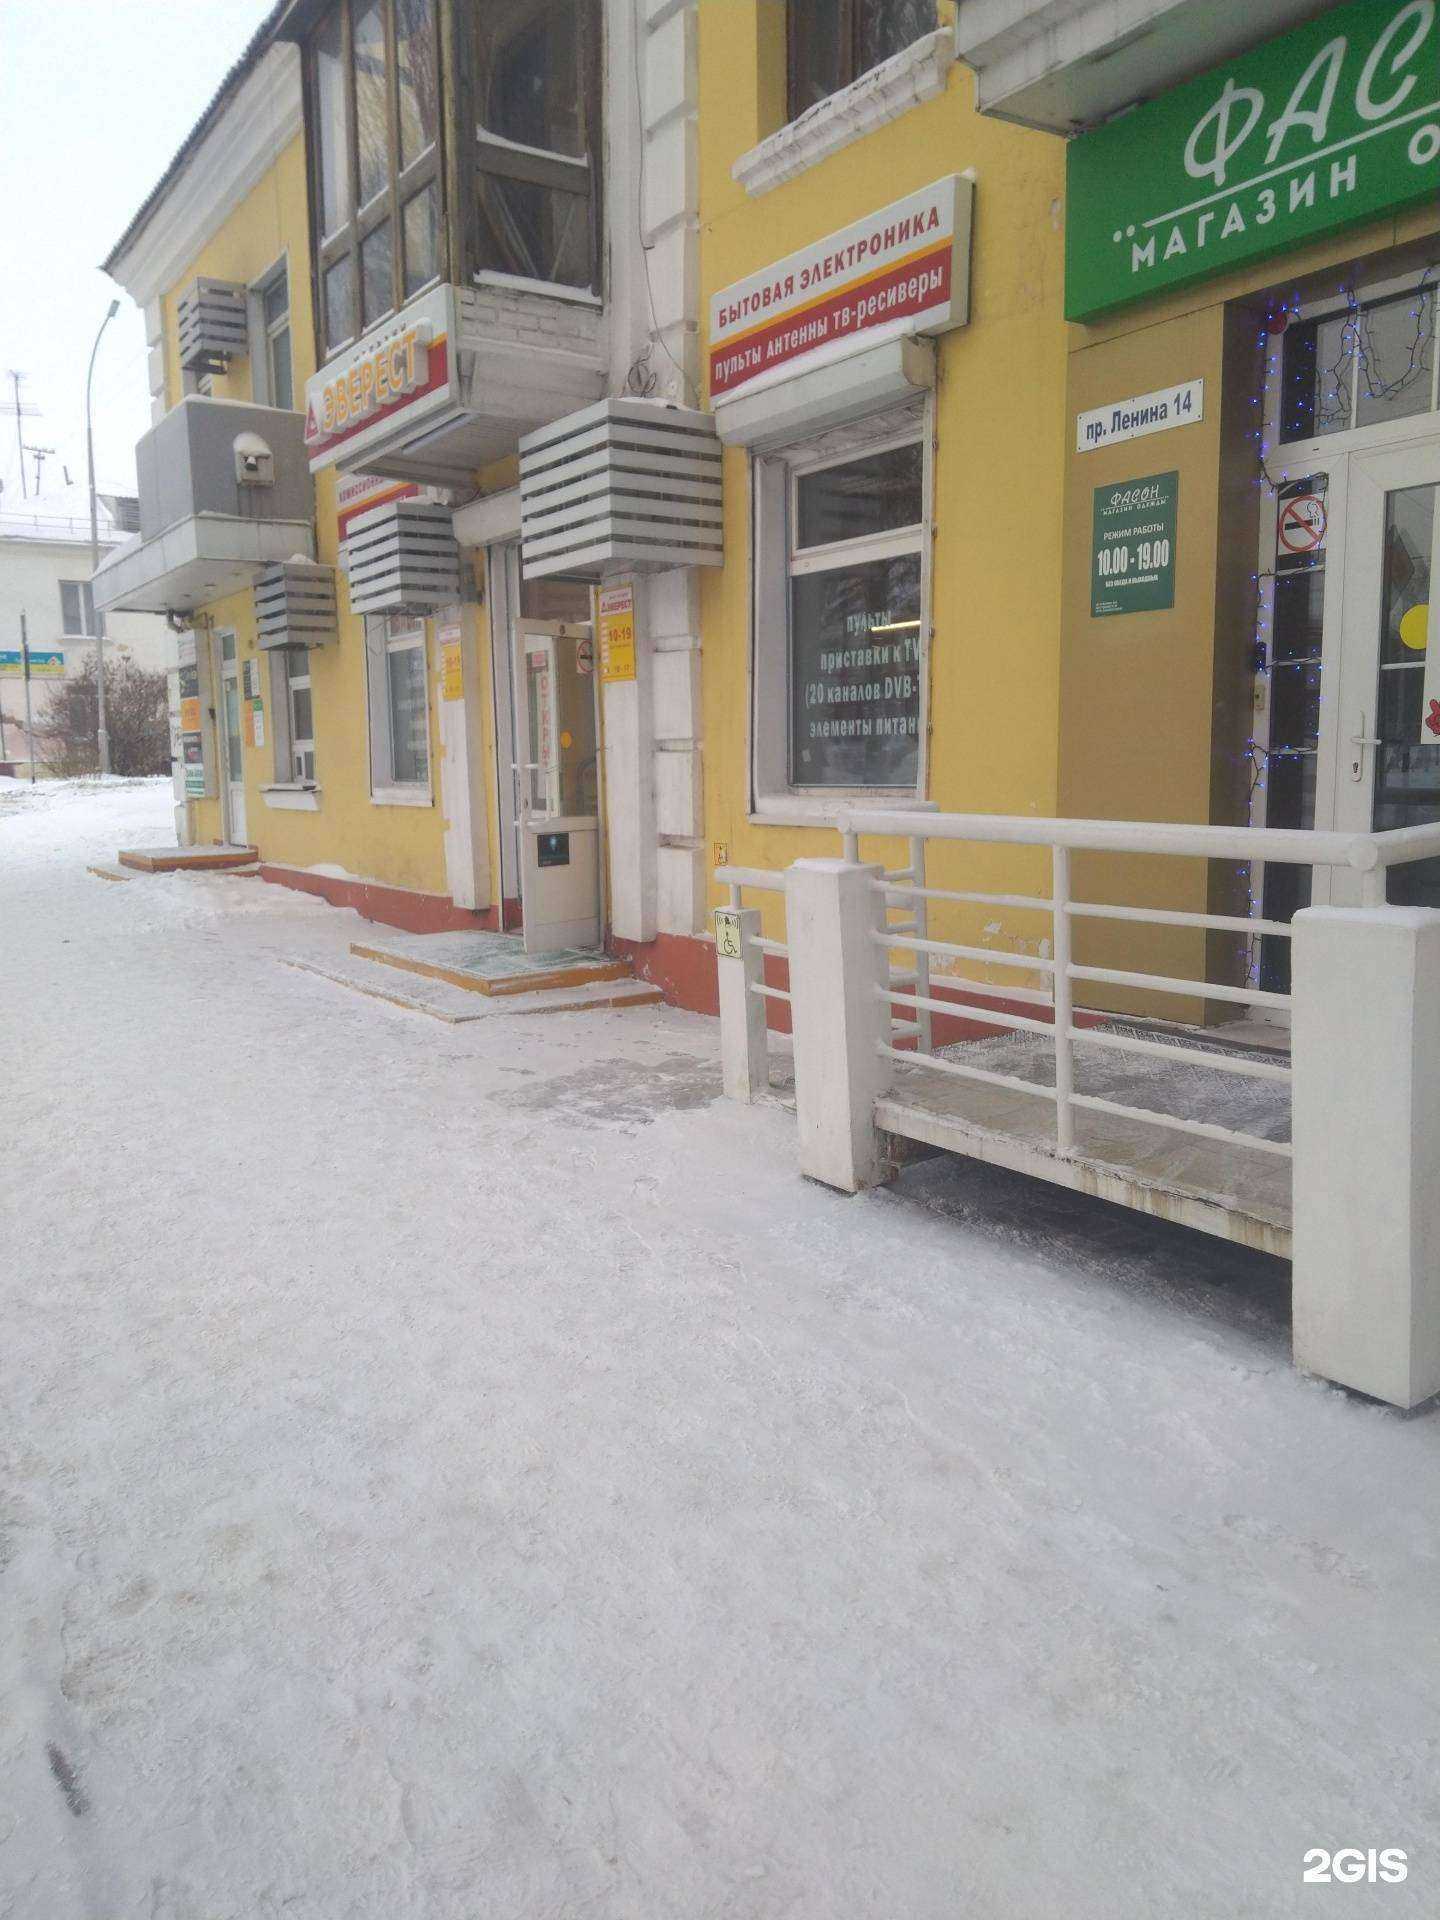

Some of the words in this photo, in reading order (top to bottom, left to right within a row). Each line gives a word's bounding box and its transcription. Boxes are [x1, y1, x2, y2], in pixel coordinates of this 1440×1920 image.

[1184, 0, 1435, 187] ФАС
[1130, 154, 1357, 273] МАГАЗИН
[718, 275, 794, 328] БЫТОВАЯ
[800, 206, 939, 290] ЭЛЕКТРОНИКА
[715, 345, 762, 383] пульты
[833, 266, 943, 330] тв-ресиверы
[322, 330, 417, 431] ЭВЕРЕСТ
[1086, 421, 1107, 443] пр.
[1111, 402, 1168, 434] Ленина
[1173, 390, 1192, 416] 14
[1110, 484, 1159, 506] ФАСОН
[1103, 528, 1132, 540] РЕЖИМ
[1133, 522, 1164, 536] РАБОТЫ
[1097, 546, 1128, 576] 10.00
[1136, 539, 1170, 570] 19.00
[820, 645, 889, 674] приставки
[893, 645, 901, 663] к
[805, 682, 824, 708] (20
[828, 682, 881, 703] каналов
[885, 674, 920, 699] DVB-
[809, 717, 872, 738] элементы
